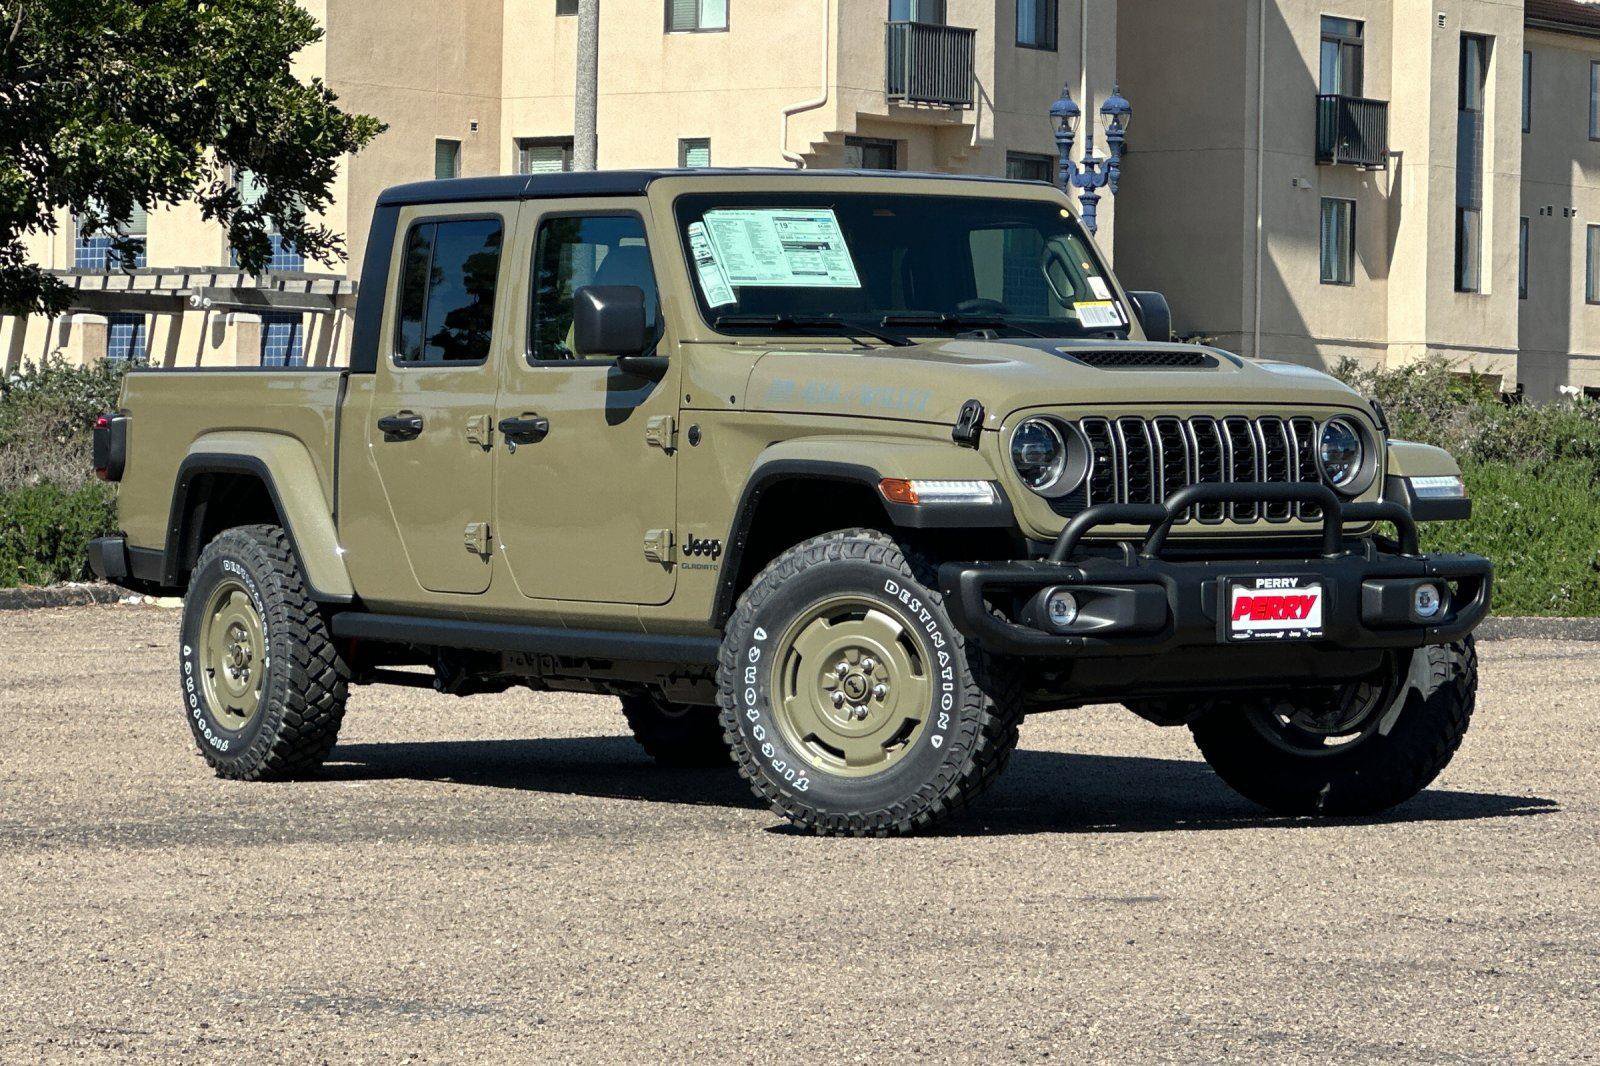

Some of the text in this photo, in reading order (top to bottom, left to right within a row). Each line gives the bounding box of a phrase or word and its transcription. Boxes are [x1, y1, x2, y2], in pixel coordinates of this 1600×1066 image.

[682, 533, 722, 561] Jeep
[681, 562, 721, 571] GLADIATO
[1256, 578, 1298, 588] PERRY
[1232, 595, 1318, 620] PERRY
[884, 579, 954, 731] DESTINATION
